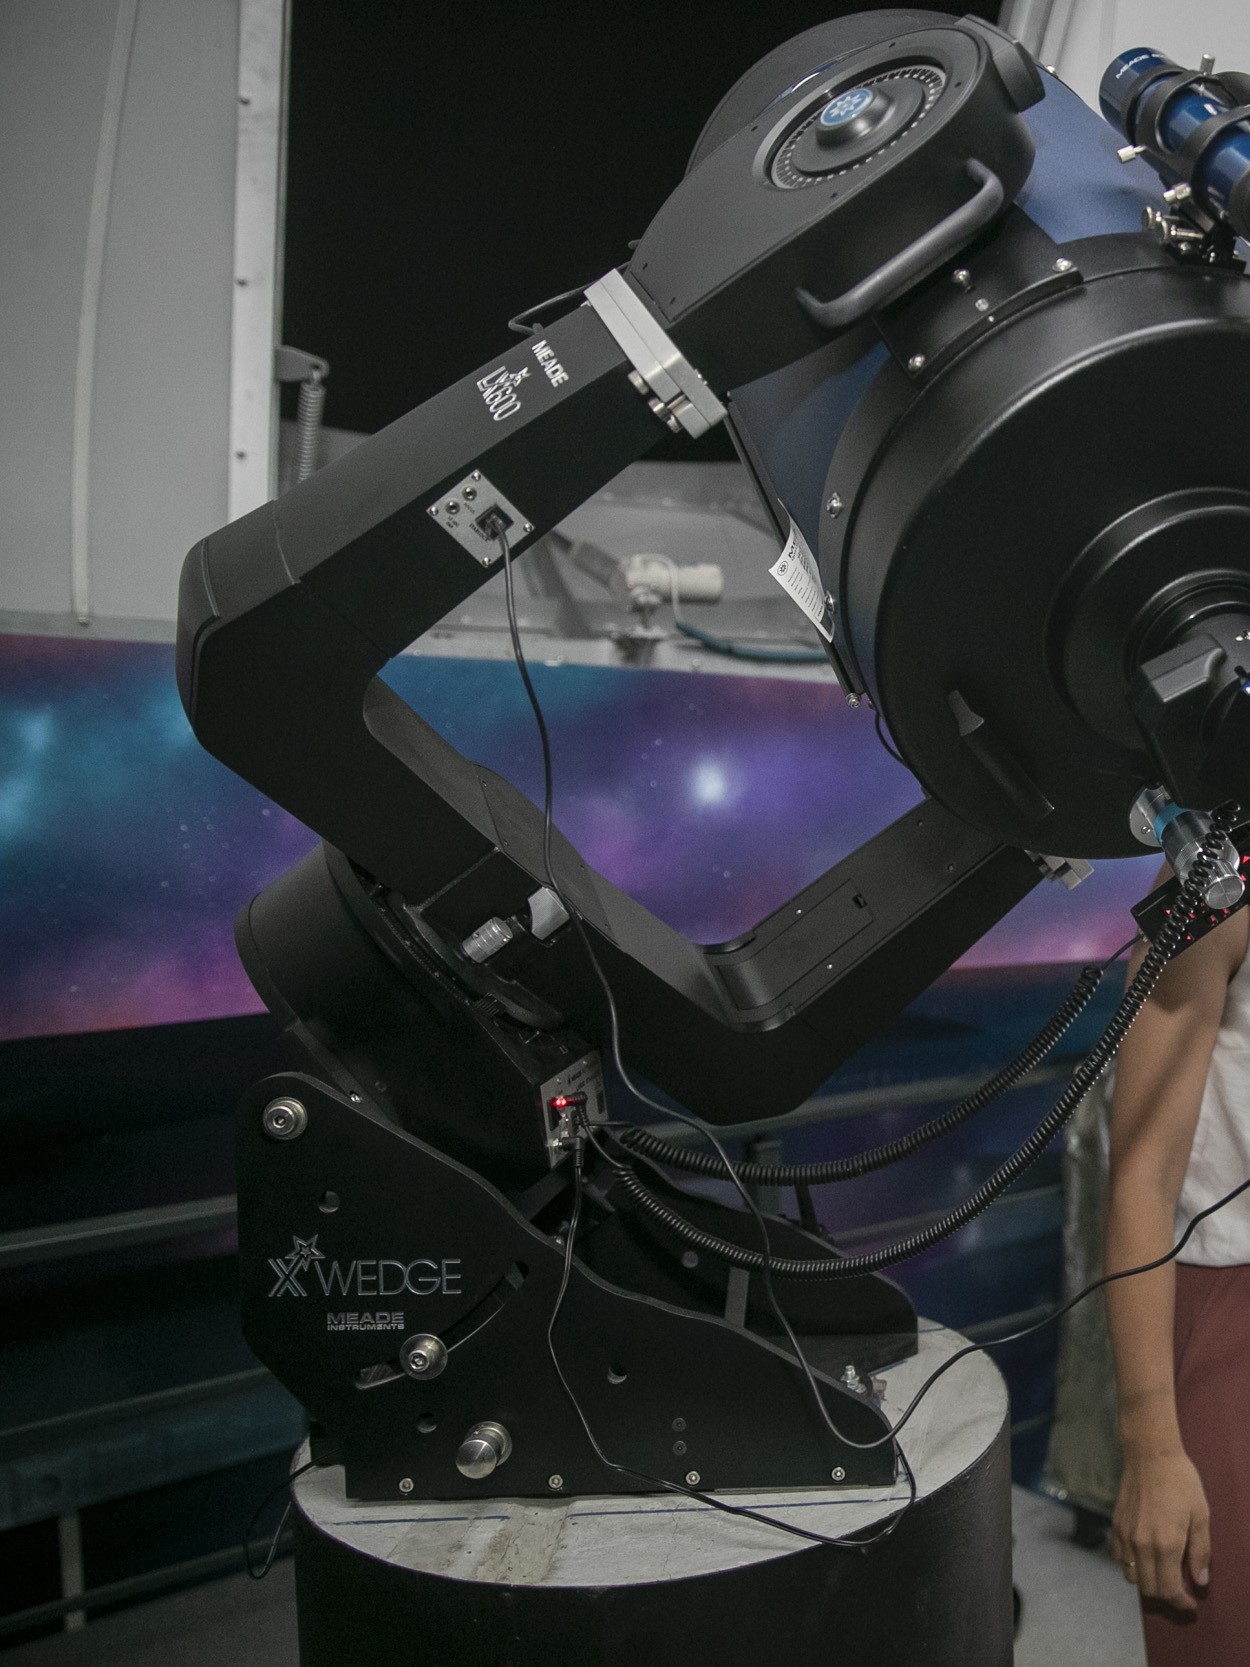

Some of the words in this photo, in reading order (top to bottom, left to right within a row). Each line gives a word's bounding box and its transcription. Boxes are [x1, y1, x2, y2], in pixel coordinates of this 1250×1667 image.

[531, 340, 569, 388] MEADE
[314, 1257, 462, 1296] WEDGE
[327, 1312, 405, 1324] MEADE
[327, 1323, 405, 1331] INSTRUMENTS
